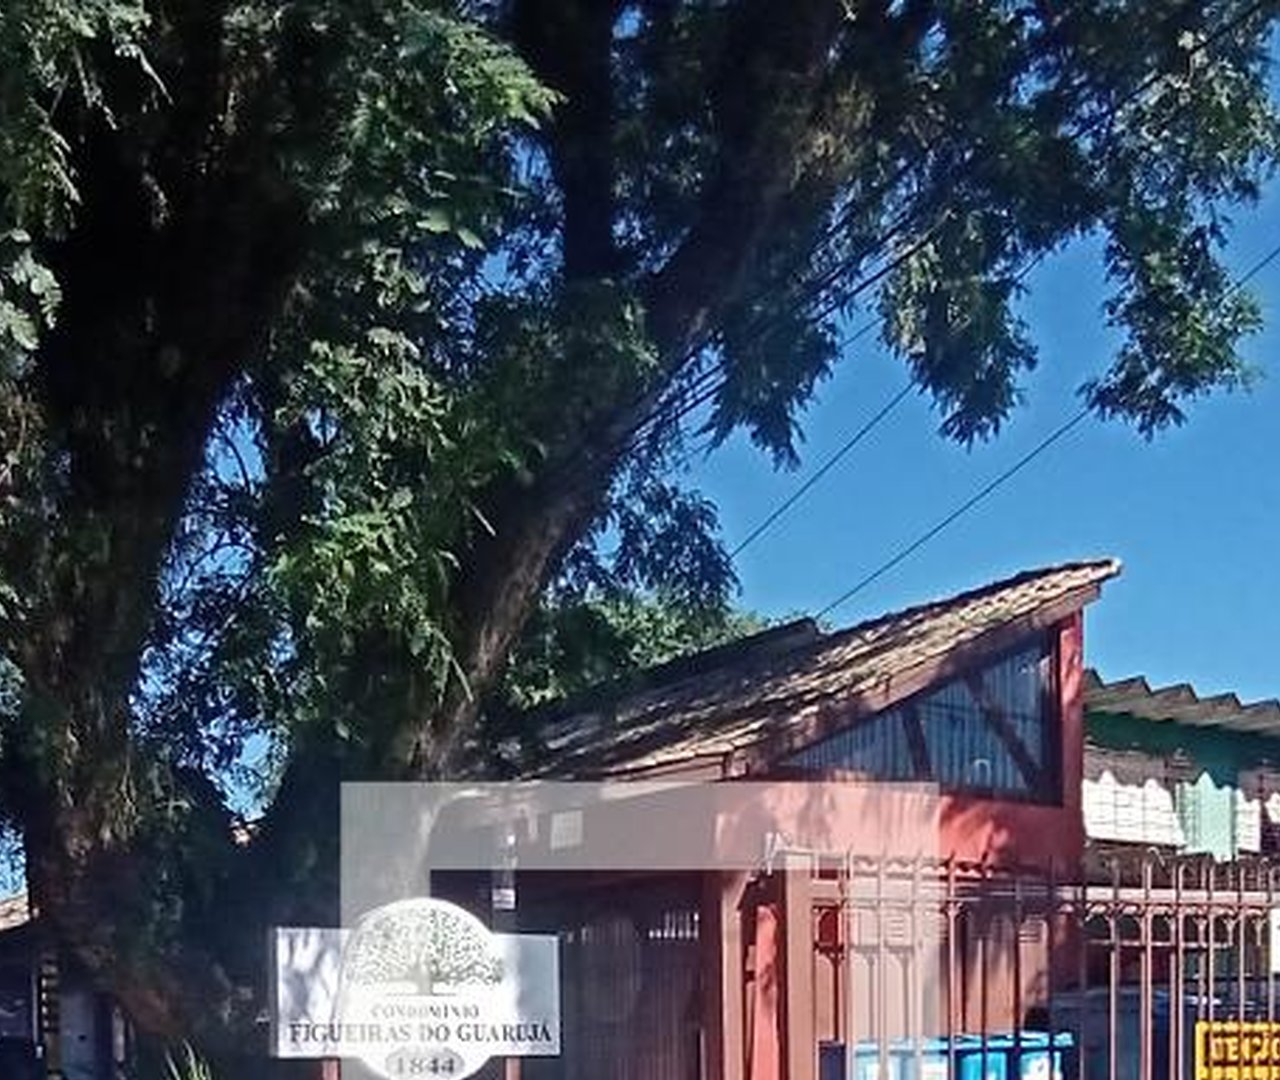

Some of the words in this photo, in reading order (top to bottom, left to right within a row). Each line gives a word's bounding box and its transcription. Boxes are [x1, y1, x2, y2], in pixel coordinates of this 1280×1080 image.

[289, 1023, 411, 1042] FIGUEIRAS
[420, 1023, 451, 1042] DO
[396, 1056, 457, 1075] 1844
